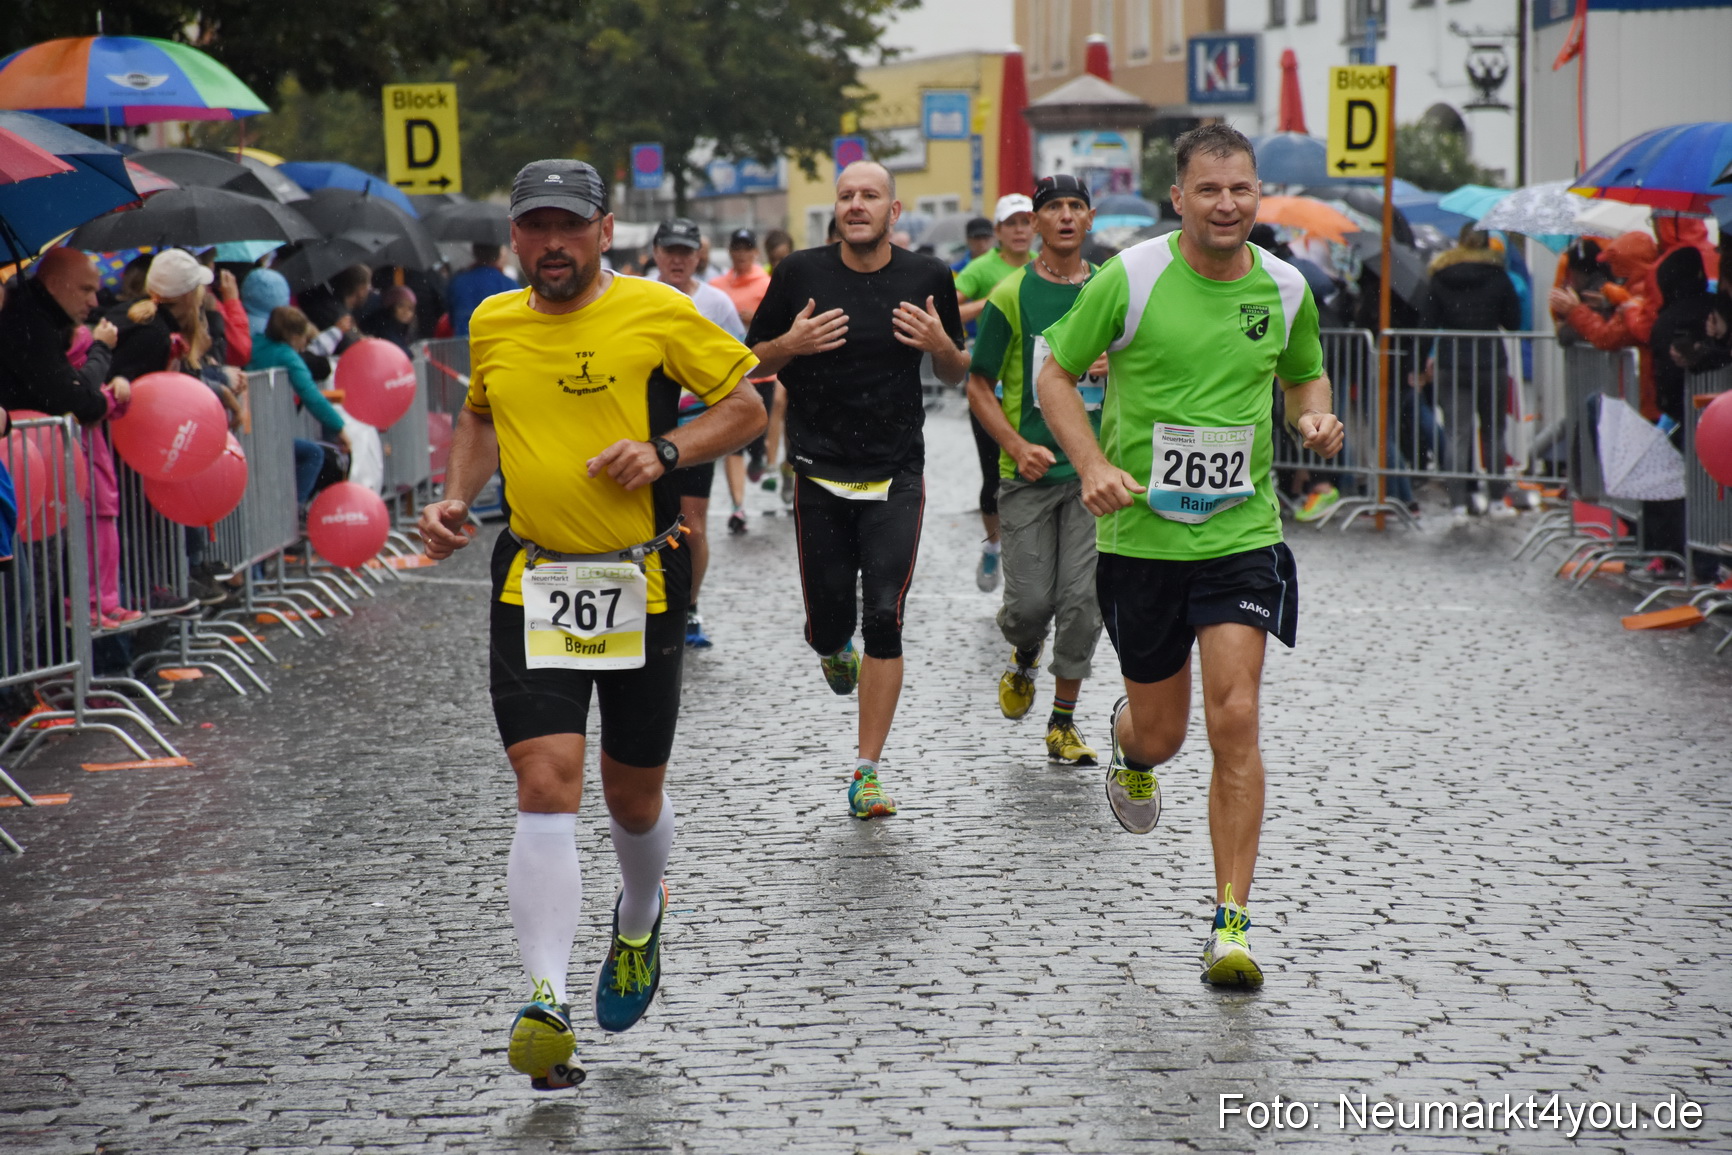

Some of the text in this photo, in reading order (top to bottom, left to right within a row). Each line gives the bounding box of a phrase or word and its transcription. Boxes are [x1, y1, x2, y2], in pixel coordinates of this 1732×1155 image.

[1195, 42, 1249, 92] KL
[1337, 71, 1389, 90] Block
[393, 88, 450, 110] Block
[1346, 99, 1377, 150] D
[405, 119, 440, 169] D
[563, 384, 608, 396] Burgthann
[1161, 435, 1196, 444] NeuerMarkt
[1202, 430, 1248, 443] BOCK
[1162, 449, 1245, 489] 2632
[1181, 496, 1220, 511] Rain
[575, 566, 636, 581] BOCK
[549, 587, 622, 631] 267
[1239, 600, 1270, 618] JAKO
[565, 637, 607, 654] Bernd
